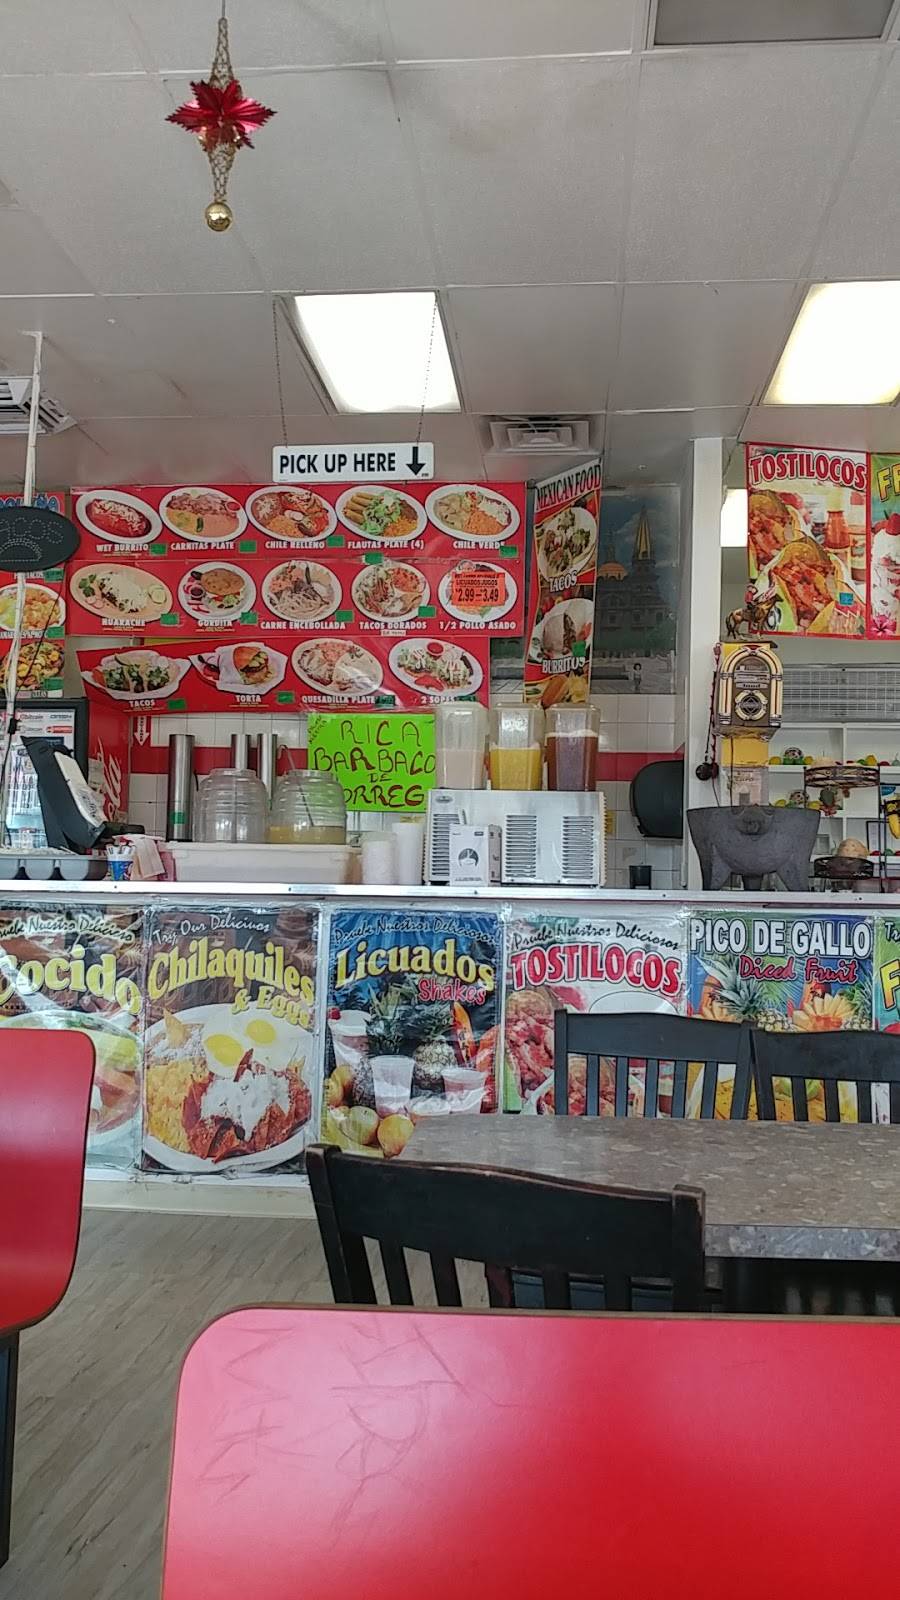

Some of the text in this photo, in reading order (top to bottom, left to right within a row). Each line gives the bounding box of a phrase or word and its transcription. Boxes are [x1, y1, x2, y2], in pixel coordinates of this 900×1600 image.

[280, 452, 396, 474] PICK UP HERE
[750, 453, 868, 490] TOSTILOCOS
[535, 464, 600, 511] MEXICAN FOOD
[96, 543, 149, 552] WET BURRITO
[170, 542, 235, 550] CARNITAS PLATE
[265, 541, 325, 549] CHILE RELLENO
[348, 539, 425, 550] FLAUTAS PLATE (4)
[453, 541, 477, 549] CHILE
[549, 570, 578, 593] TACOS
[102, 618, 146, 627] HUARACHE
[260, 621, 346, 630] CARNE ENCEBOLLADA
[359, 621, 427, 630] TACOS DORADOS
[439, 621, 516, 630] 1/2 POLLO ASADO
[542, 657, 586, 674] BURRITOS
[129, 699, 156, 708] TACOS
[235, 694, 262, 703] TORTA
[302, 695, 376, 704] QUESADILLA PLATE
[421, 696, 428, 704] 2
[340, 720, 422, 747] RICA
[28, 913, 76, 933] Nuestro
[80, 916, 133, 941] Delicioso
[153, 929, 178, 946] Try
[180, 919, 207, 934] Our
[335, 922, 374, 942] Pruebe
[377, 918, 428, 933] Nuestros
[514, 921, 679, 950] Pruebe Nuestros Deliciosos
[689, 918, 873, 957] PICO DE GALLO
[148, 936, 315, 1006] Chilaquiles
[335, 938, 495, 992] Licuados
[510, 943, 682, 996] TOSTILOCOS
[739, 955, 859, 983] Diced Fruit
[418, 978, 487, 1005] Shakes
[231, 985, 311, 1028] & Eggs
